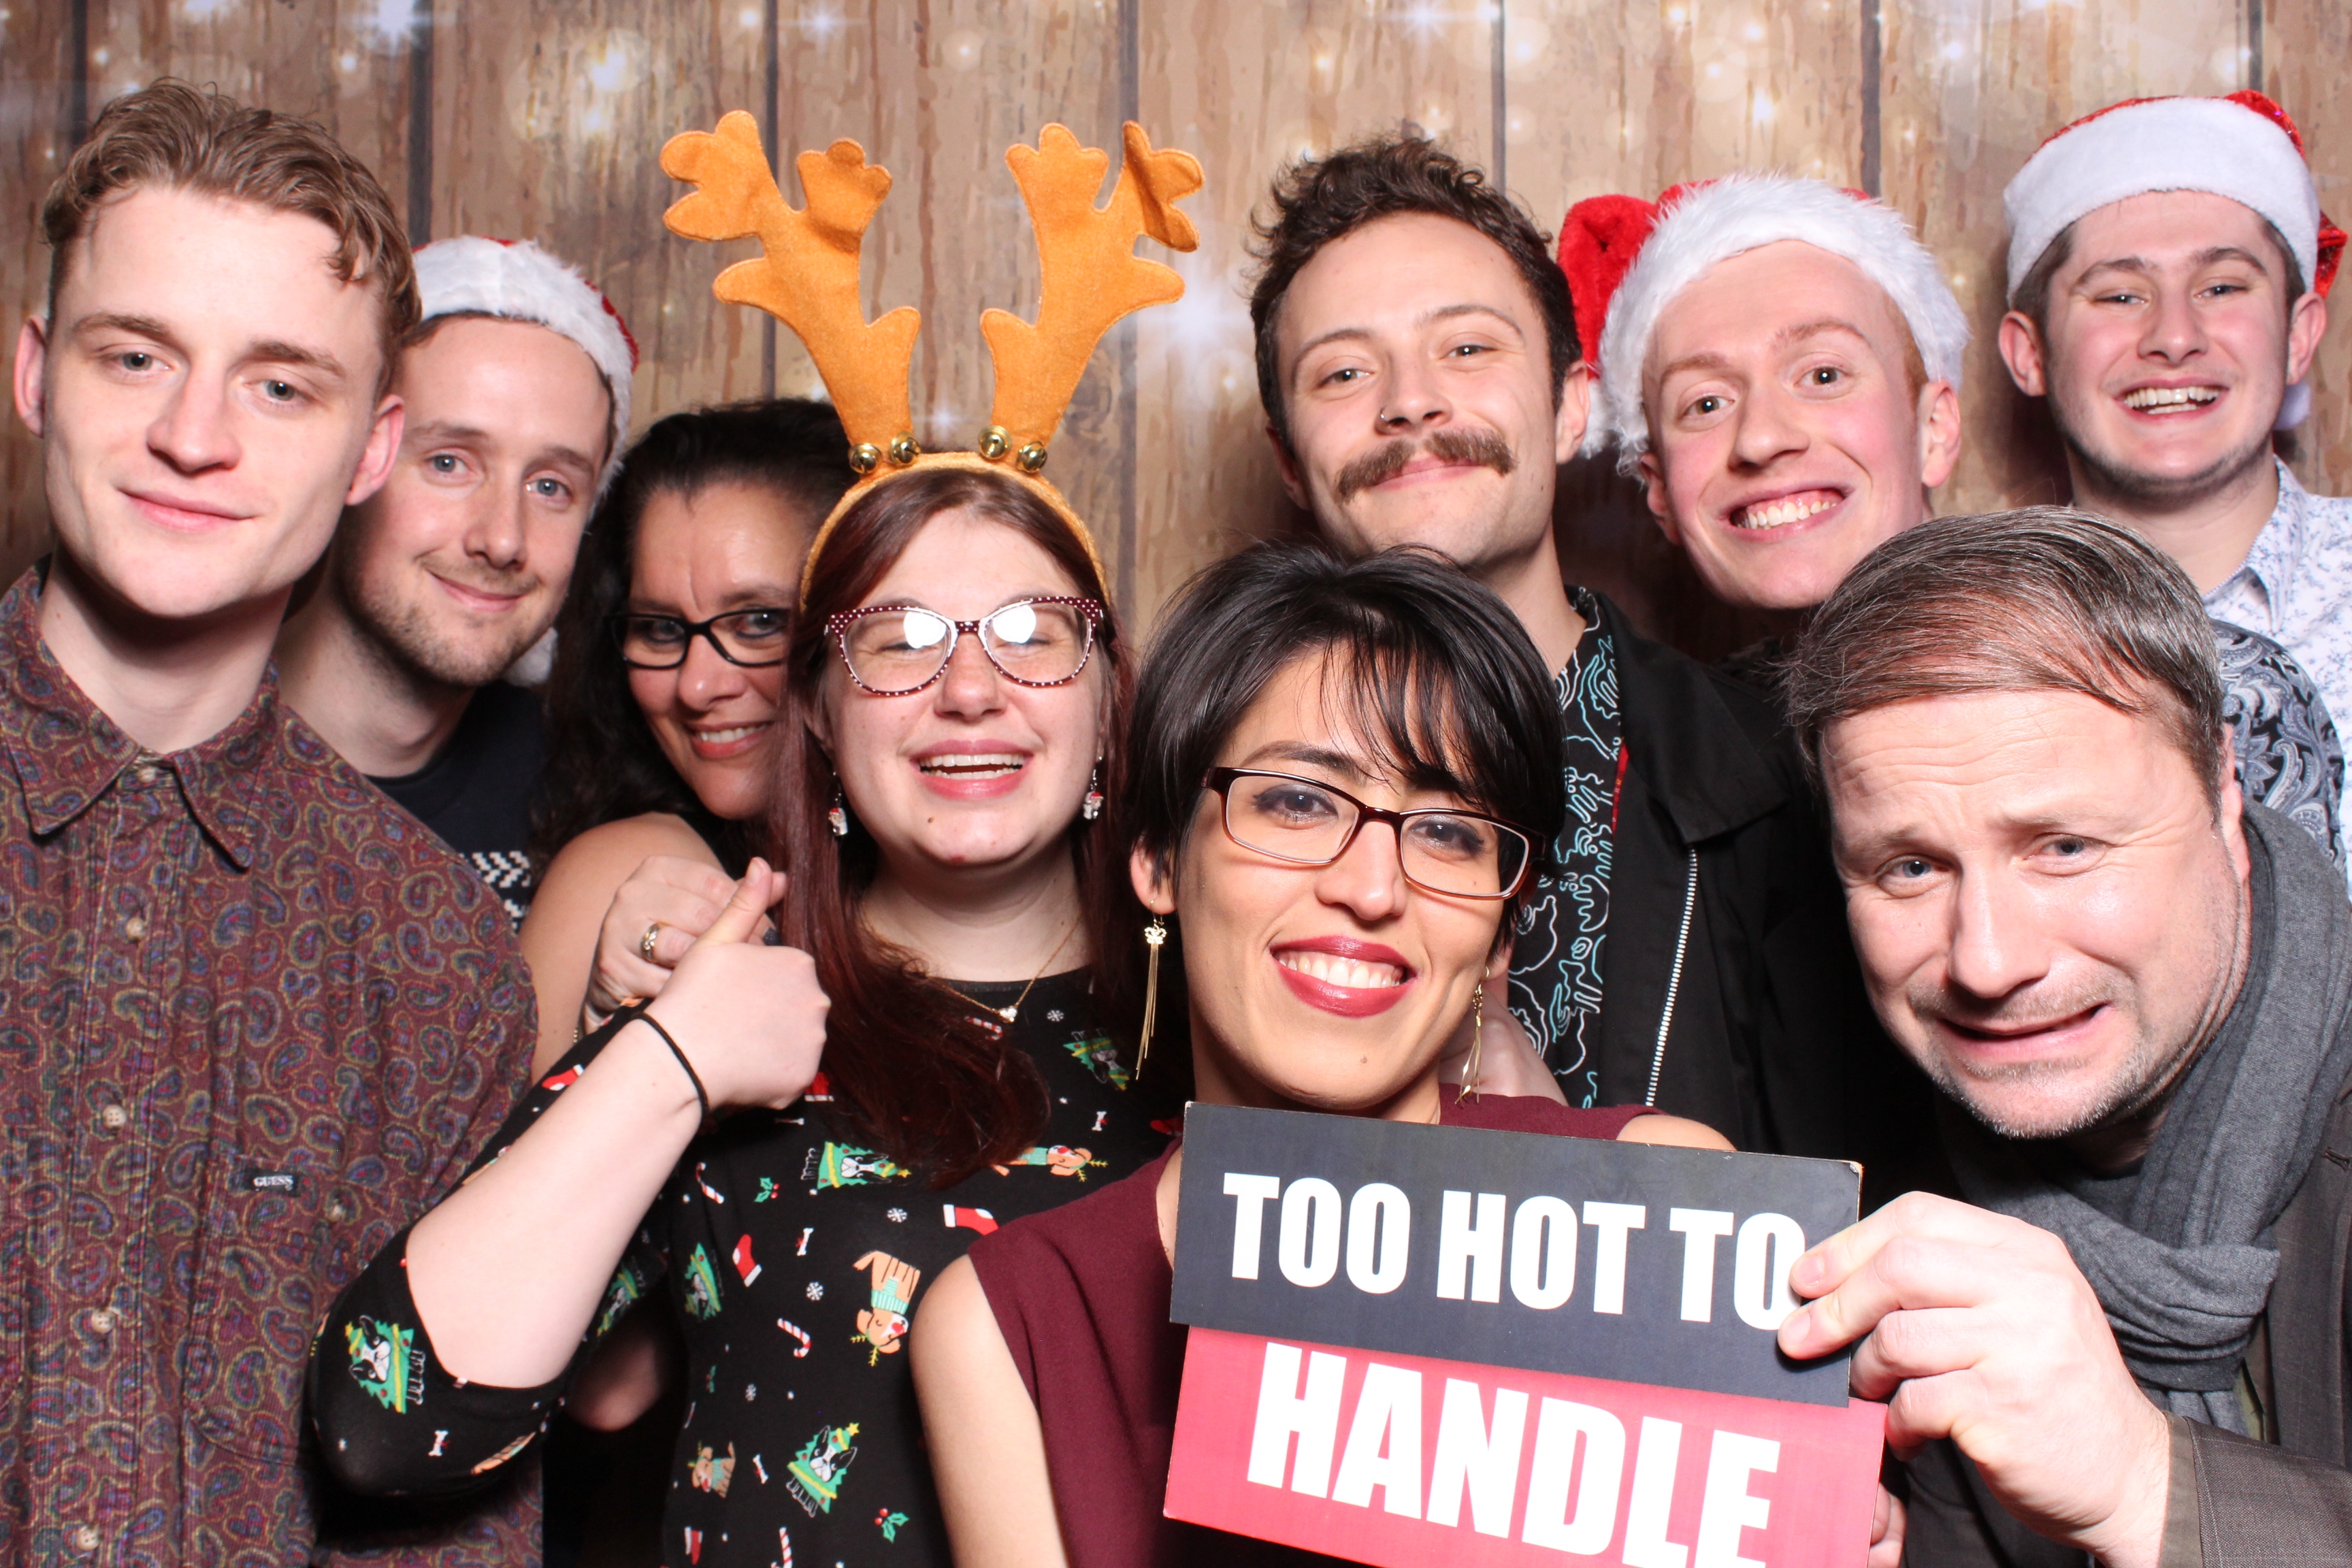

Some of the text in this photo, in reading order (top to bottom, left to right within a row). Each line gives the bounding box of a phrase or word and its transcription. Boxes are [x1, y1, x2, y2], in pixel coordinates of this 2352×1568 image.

[1223, 1172, 1806, 1331] TOO HOT TO
[1246, 1341, 1781, 1568] HANDLE
